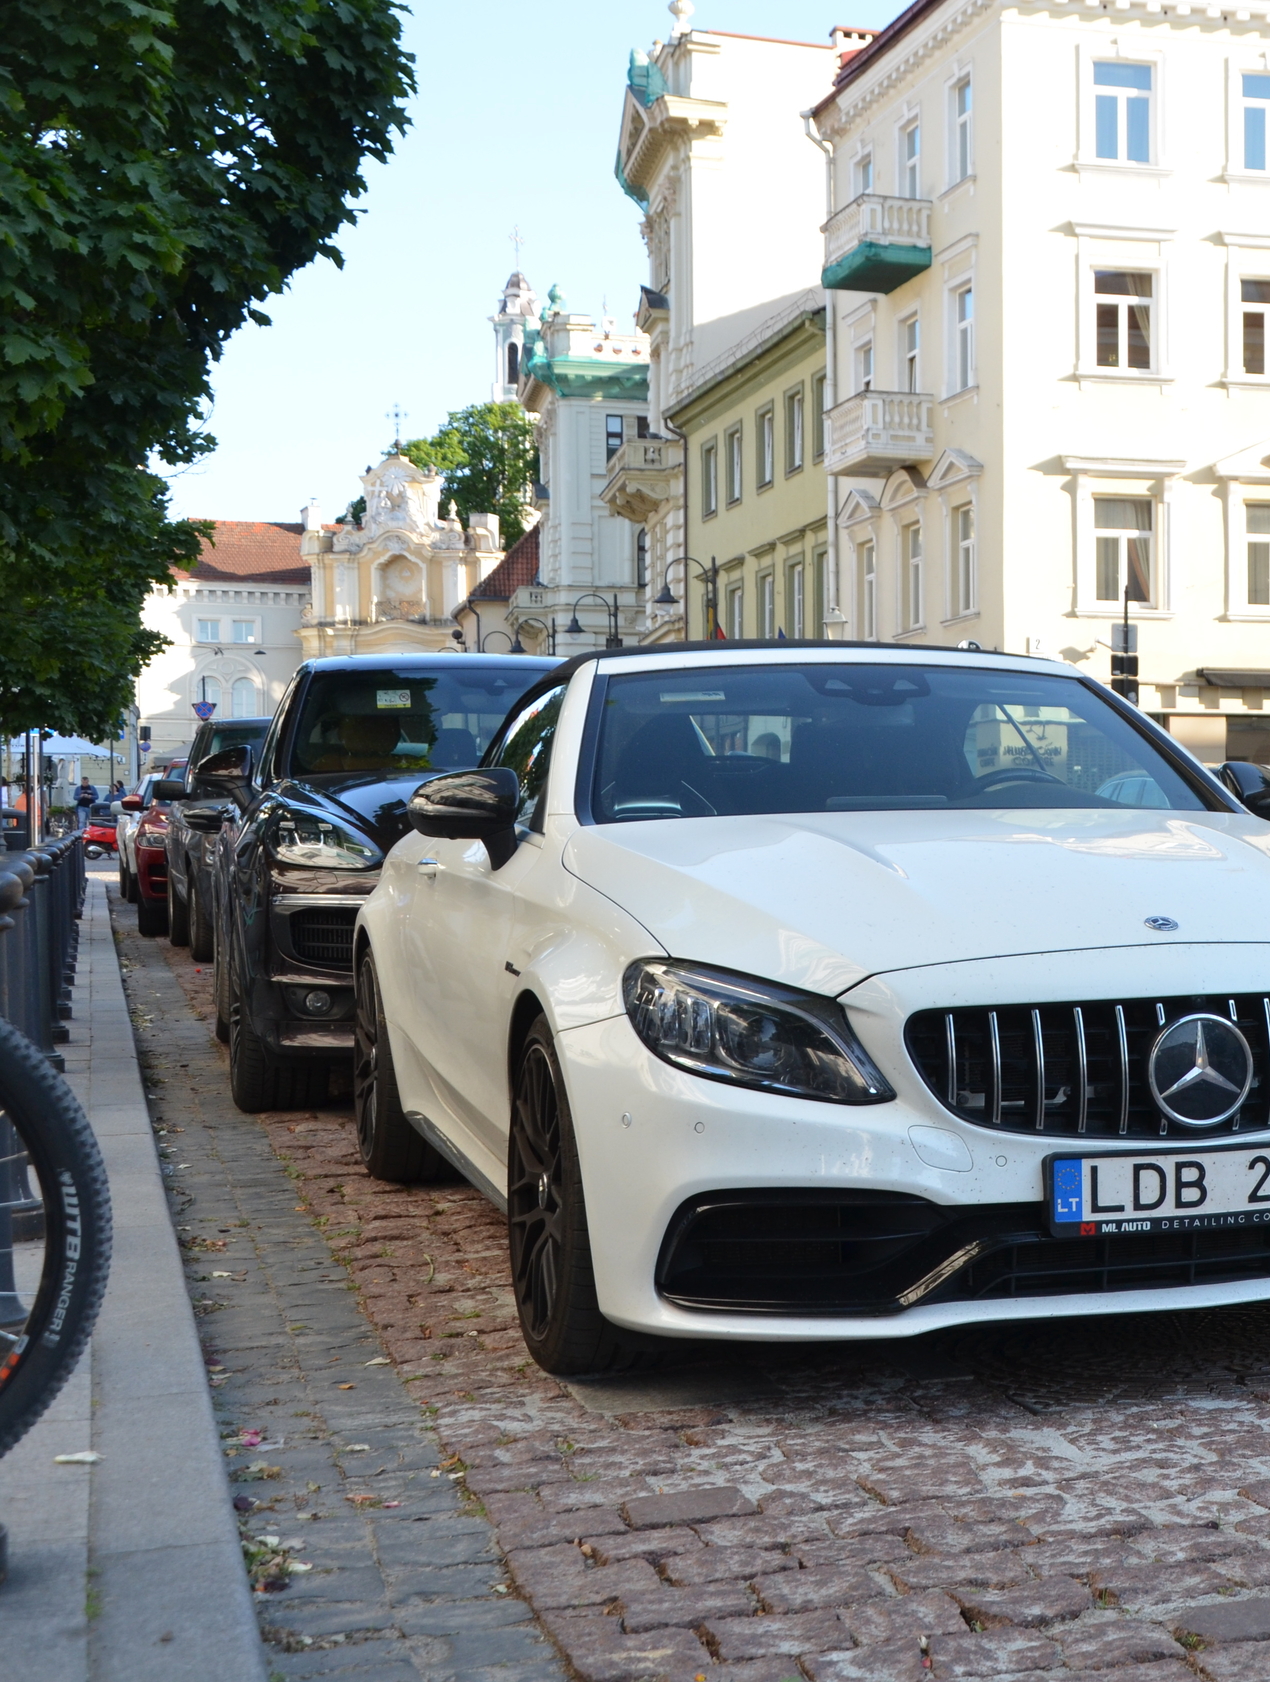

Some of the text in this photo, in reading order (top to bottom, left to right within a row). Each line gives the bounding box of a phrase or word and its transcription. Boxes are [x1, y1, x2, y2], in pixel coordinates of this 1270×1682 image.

[1057, 1198, 1080, 1213] LT
[1090, 1160, 1207, 1213] LDB
[1101, 1222, 1119, 1233] ML
[1121, 1220, 1151, 1232] AUTO
[1162, 1214, 1246, 1229] DETAILING
[50, 1261, 77, 1335] RANGER
